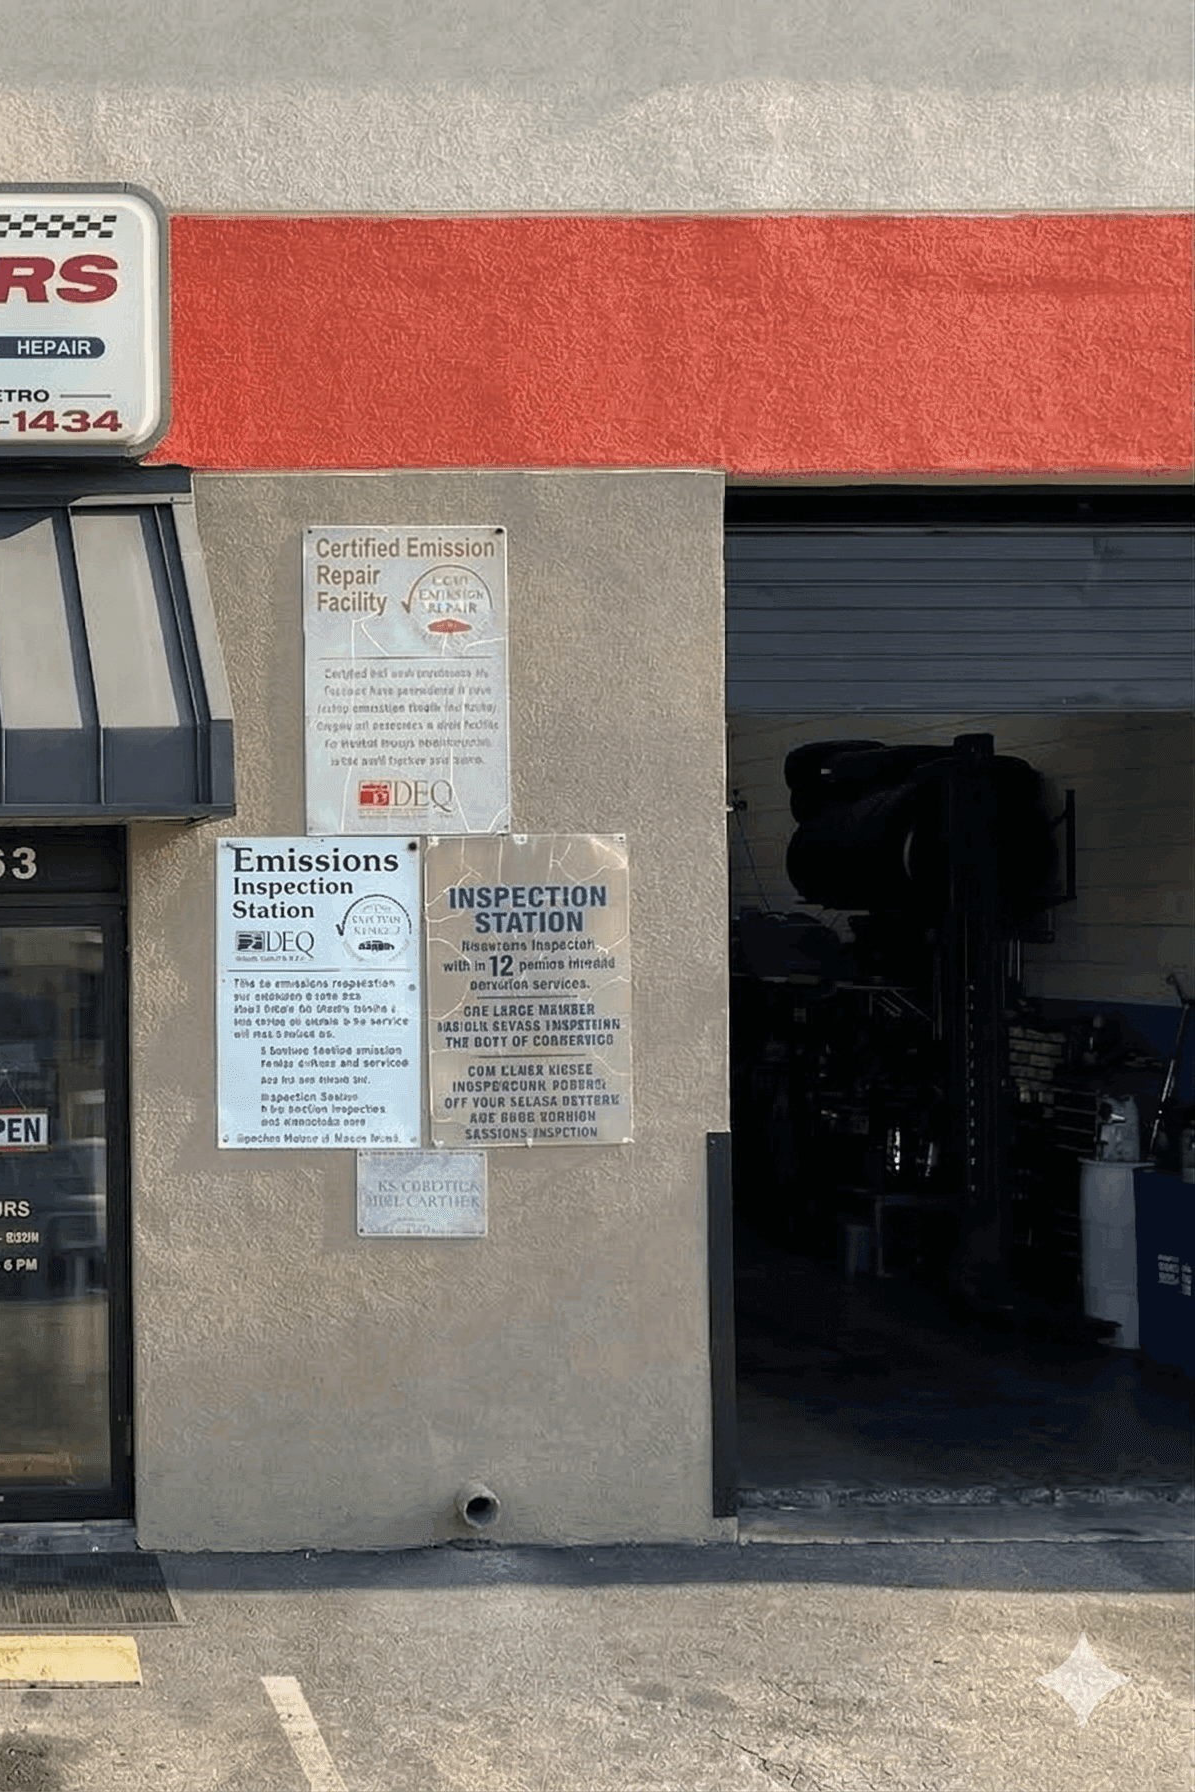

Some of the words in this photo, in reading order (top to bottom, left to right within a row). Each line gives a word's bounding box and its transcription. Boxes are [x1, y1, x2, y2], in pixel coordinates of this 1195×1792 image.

[316, 537, 399, 559] Certified
[407, 536, 495, 558] Emission
[316, 565, 381, 589] Repair
[317, 592, 387, 617] Facility
[391, 779, 453, 812] DEQ
[232, 847, 399, 872] Emissions
[233, 877, 354, 899] Inspection
[449, 885, 607, 909] INSPECTION
[232, 900, 314, 919] Station
[475, 911, 584, 934] STATION
[266, 930, 315, 959] DEQ
[474, 961, 486, 971] in
[489, 955, 514, 977] 12
[532, 977, 591, 990] services.
[511, 1035, 529, 1047] OF
[467, 1065, 496, 1077] COM
[444, 1097, 469, 1109] OFF
[472, 1096, 506, 1109] YOUR
[465, 1127, 528, 1140] SASSIONS
[16, 1258, 38, 1271] PM
